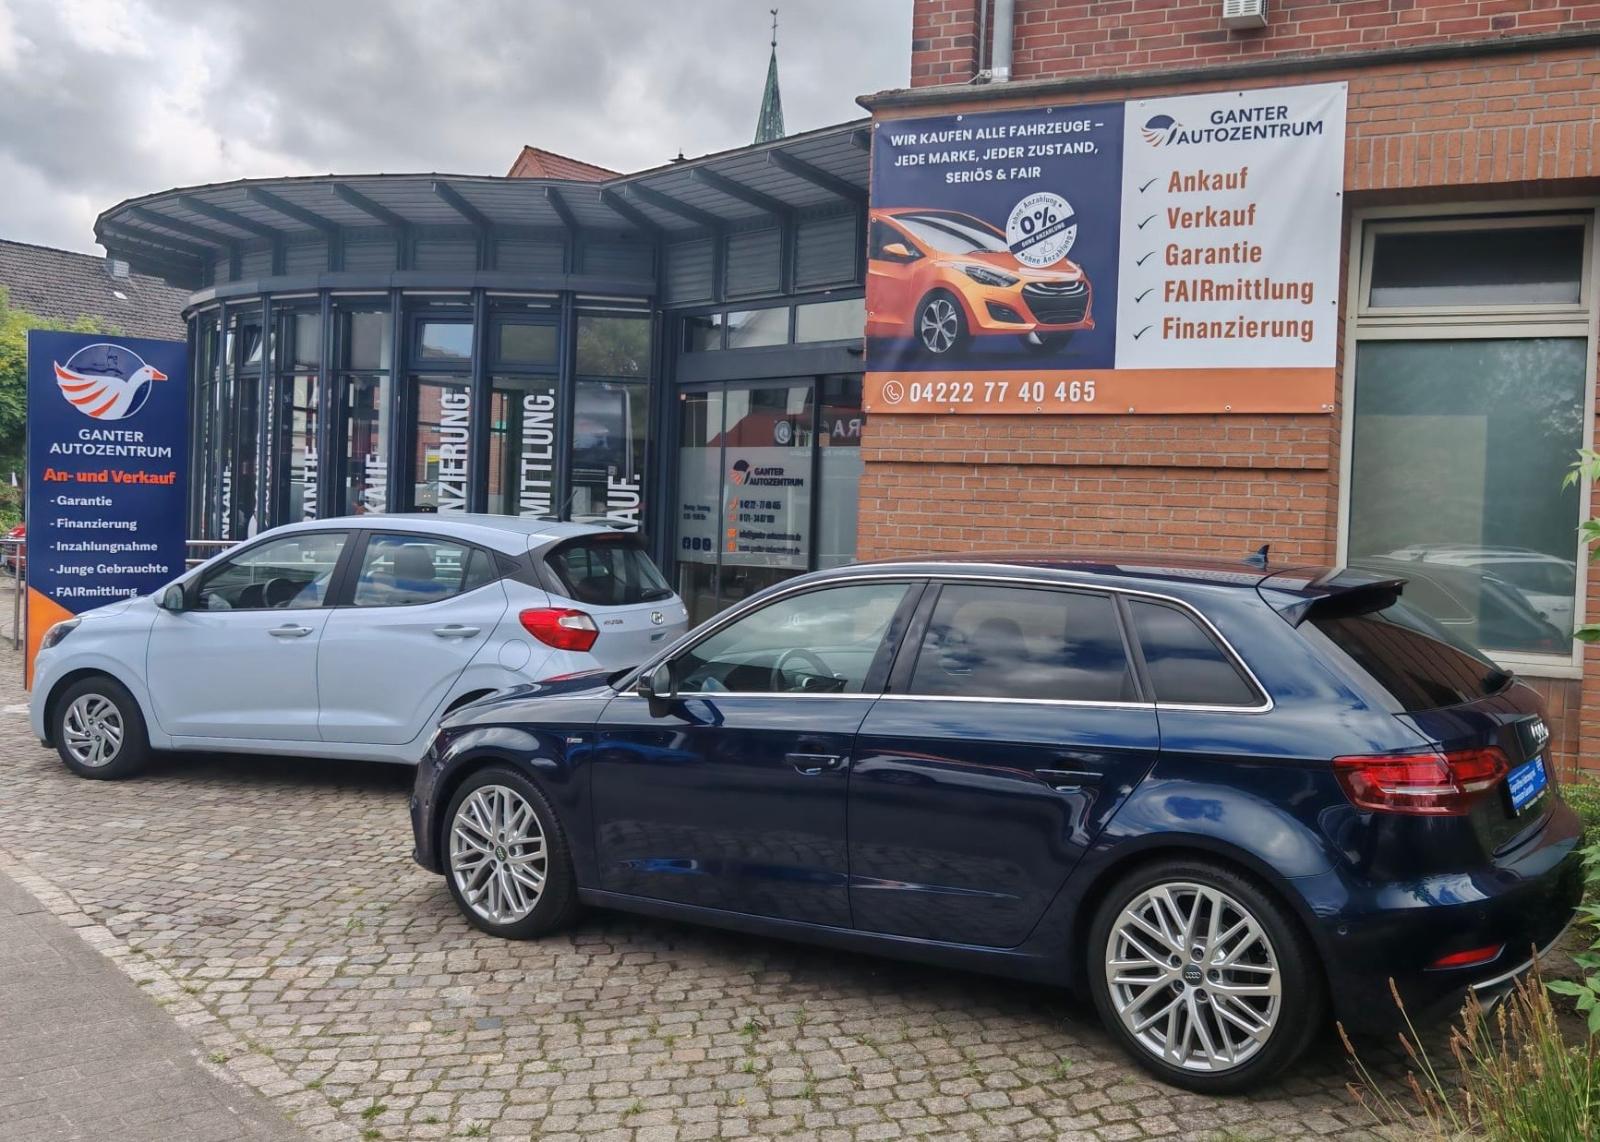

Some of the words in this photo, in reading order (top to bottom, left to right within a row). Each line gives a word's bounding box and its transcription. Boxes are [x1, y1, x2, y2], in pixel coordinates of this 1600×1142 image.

[1210, 106, 1288, 125] GANTER
[891, 134, 916, 146] WIR
[920, 130, 972, 143] KAUFEN
[976, 126, 1006, 139] ALLE
[1010, 120, 1090, 137] FAHRZEUGE
[1177, 120, 1323, 145] AUTOZENTRUM
[894, 154, 924, 166] JEDE
[929, 150, 979, 164] MARKE,
[983, 147, 1024, 160] JEDER
[1028, 142, 1098, 156] ZUSTAND,
[946, 168, 992, 183] SERIÖS
[996, 169, 1006, 180] &
[1011, 166, 1041, 179] FAIR
[1168, 167, 1248, 193] Ankauf
[1020, 206, 1056, 234] 0%
[1168, 204, 1256, 229] Verkauf
[1166, 241, 1262, 266] Garantie
[1164, 278, 1314, 304] FAIRmittlung
[1163, 316, 1314, 342] Finanzierung
[910, 382, 974, 403] 04222
[984, 382, 1008, 402] 77
[1018, 381, 1044, 402] 40
[1054, 380, 1096, 402] 465
[79, 429, 143, 442] GANTER
[50, 442, 172, 458] AUTOZENTRUM
[44, 468, 74, 482] An-
[77, 469, 108, 483] und
[111, 470, 176, 484] Verkauf
[754, 468, 784, 476] GANTER
[750, 478, 804, 487] AUTOZENTRUM
[57, 496, 112, 506] Garantie
[57, 518, 137, 530] Finanzierung
[56, 541, 158, 553] Inzahlungnahme
[56, 563, 94, 575] Junge
[97, 563, 168, 574] Gebrauchte
[56, 586, 137, 598] FAIRmittlung
